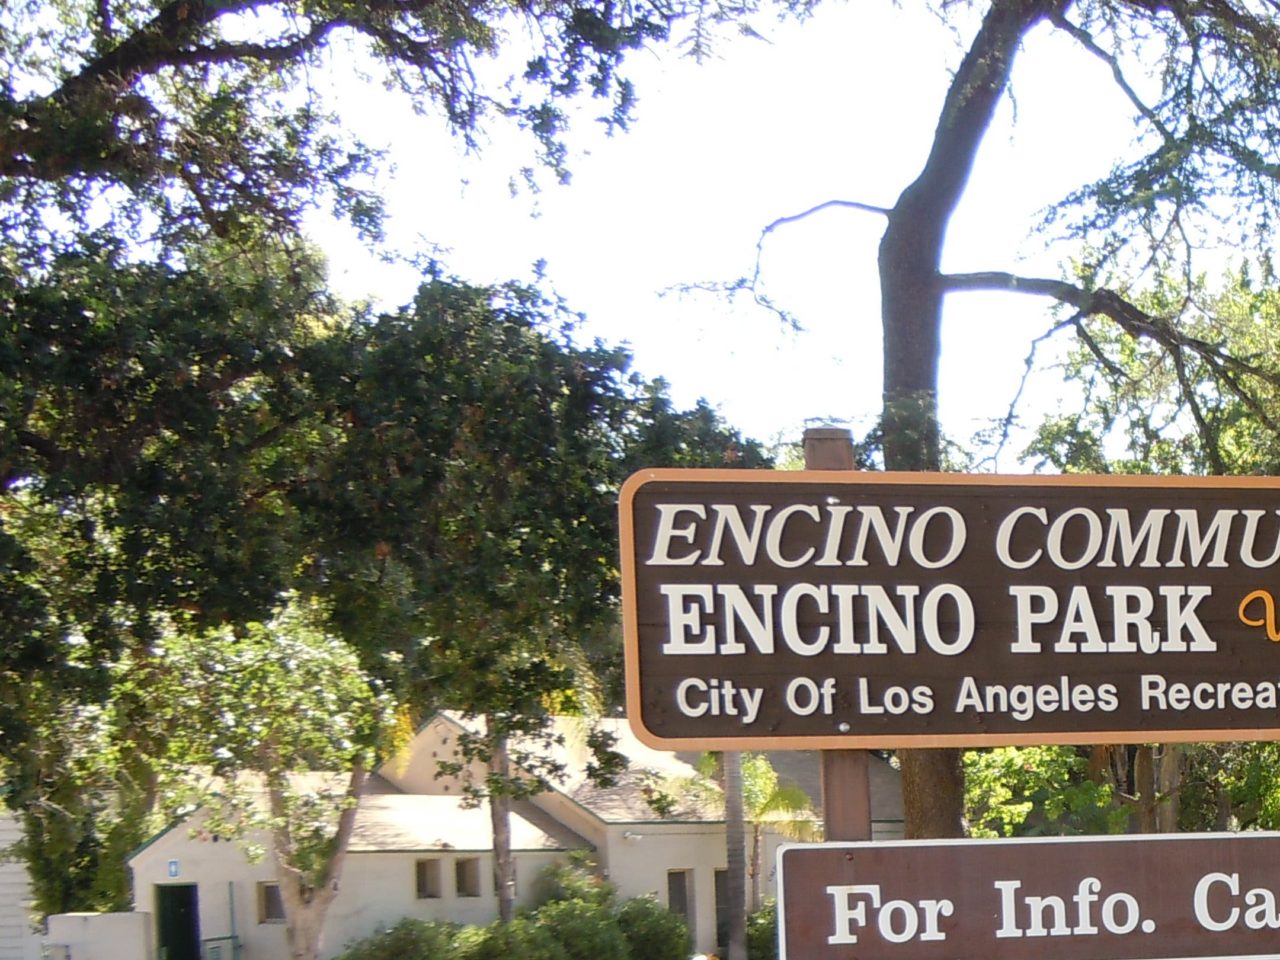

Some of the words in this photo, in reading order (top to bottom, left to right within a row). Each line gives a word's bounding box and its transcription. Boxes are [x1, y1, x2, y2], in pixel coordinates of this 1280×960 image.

[646, 504, 967, 569] ENCINO
[660, 583, 976, 655] ENCINO
[1009, 586, 1217, 653] PARK
[678, 678, 763, 723] City
[787, 678, 835, 715] Of
[860, 678, 934, 714] Los
[956, 676, 1119, 721] Angeles
[826, 884, 953, 945] For
[994, 877, 1155, 939] Info.
